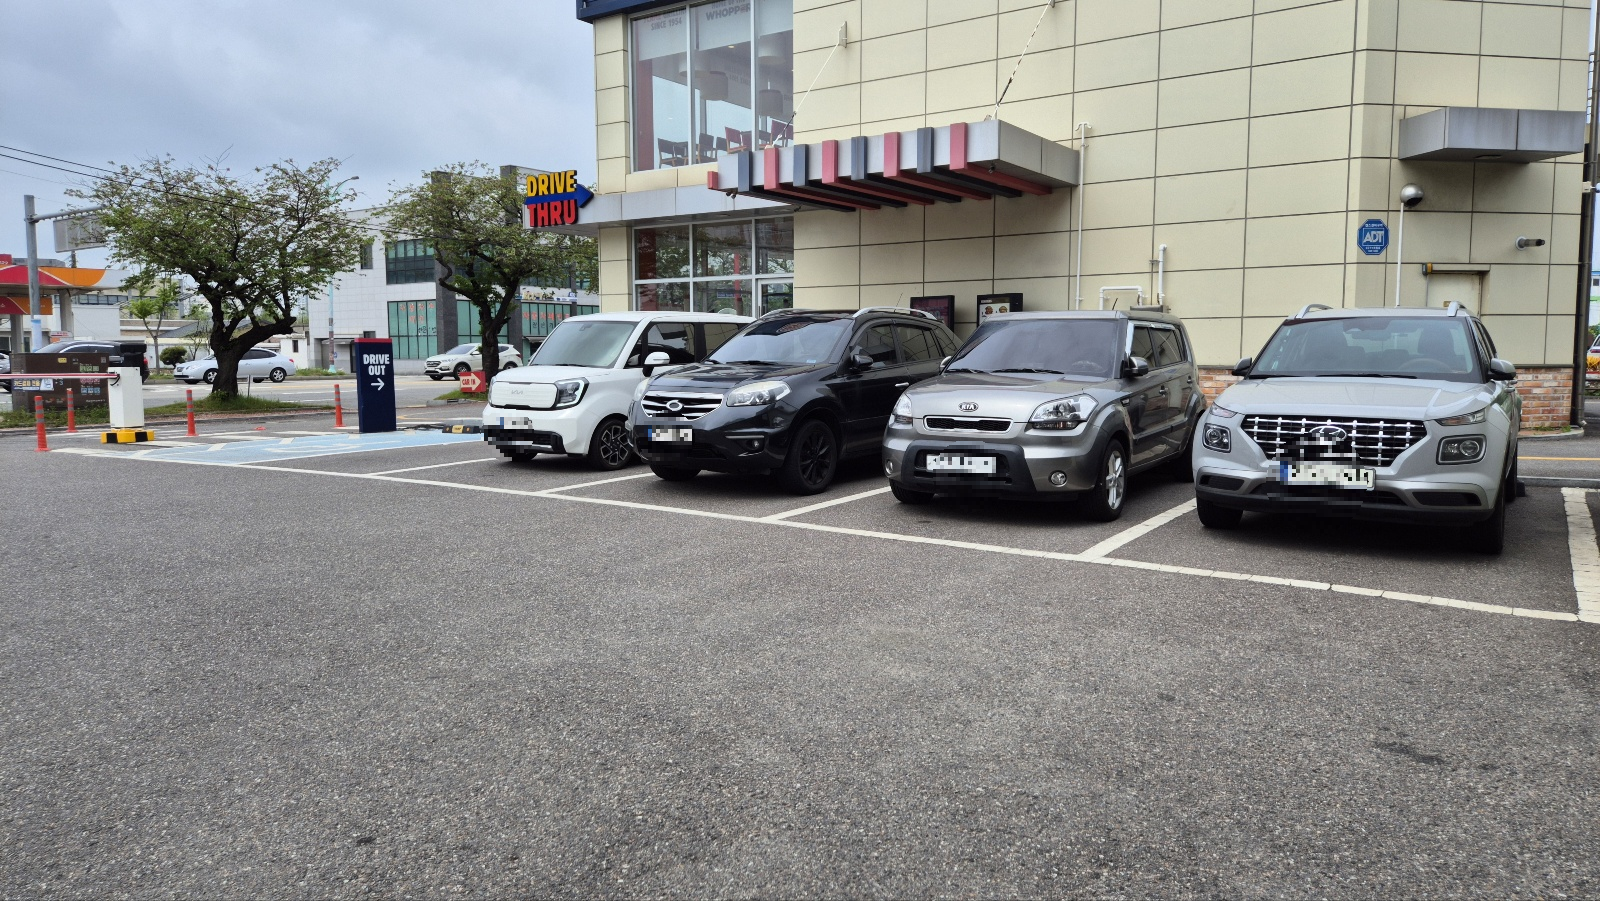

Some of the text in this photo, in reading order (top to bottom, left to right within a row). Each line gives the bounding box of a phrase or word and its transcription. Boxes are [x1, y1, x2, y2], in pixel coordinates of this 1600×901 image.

[651, 20, 667, 30] SINCE
[526, 170, 576, 197] DRIVE
[527, 199, 577, 228] THRU
[1363, 231, 1385, 243] ADT
[363, 354, 390, 365] DRIVE
[368, 365, 386, 376] OUT
[461, 378, 470, 386] CAR
